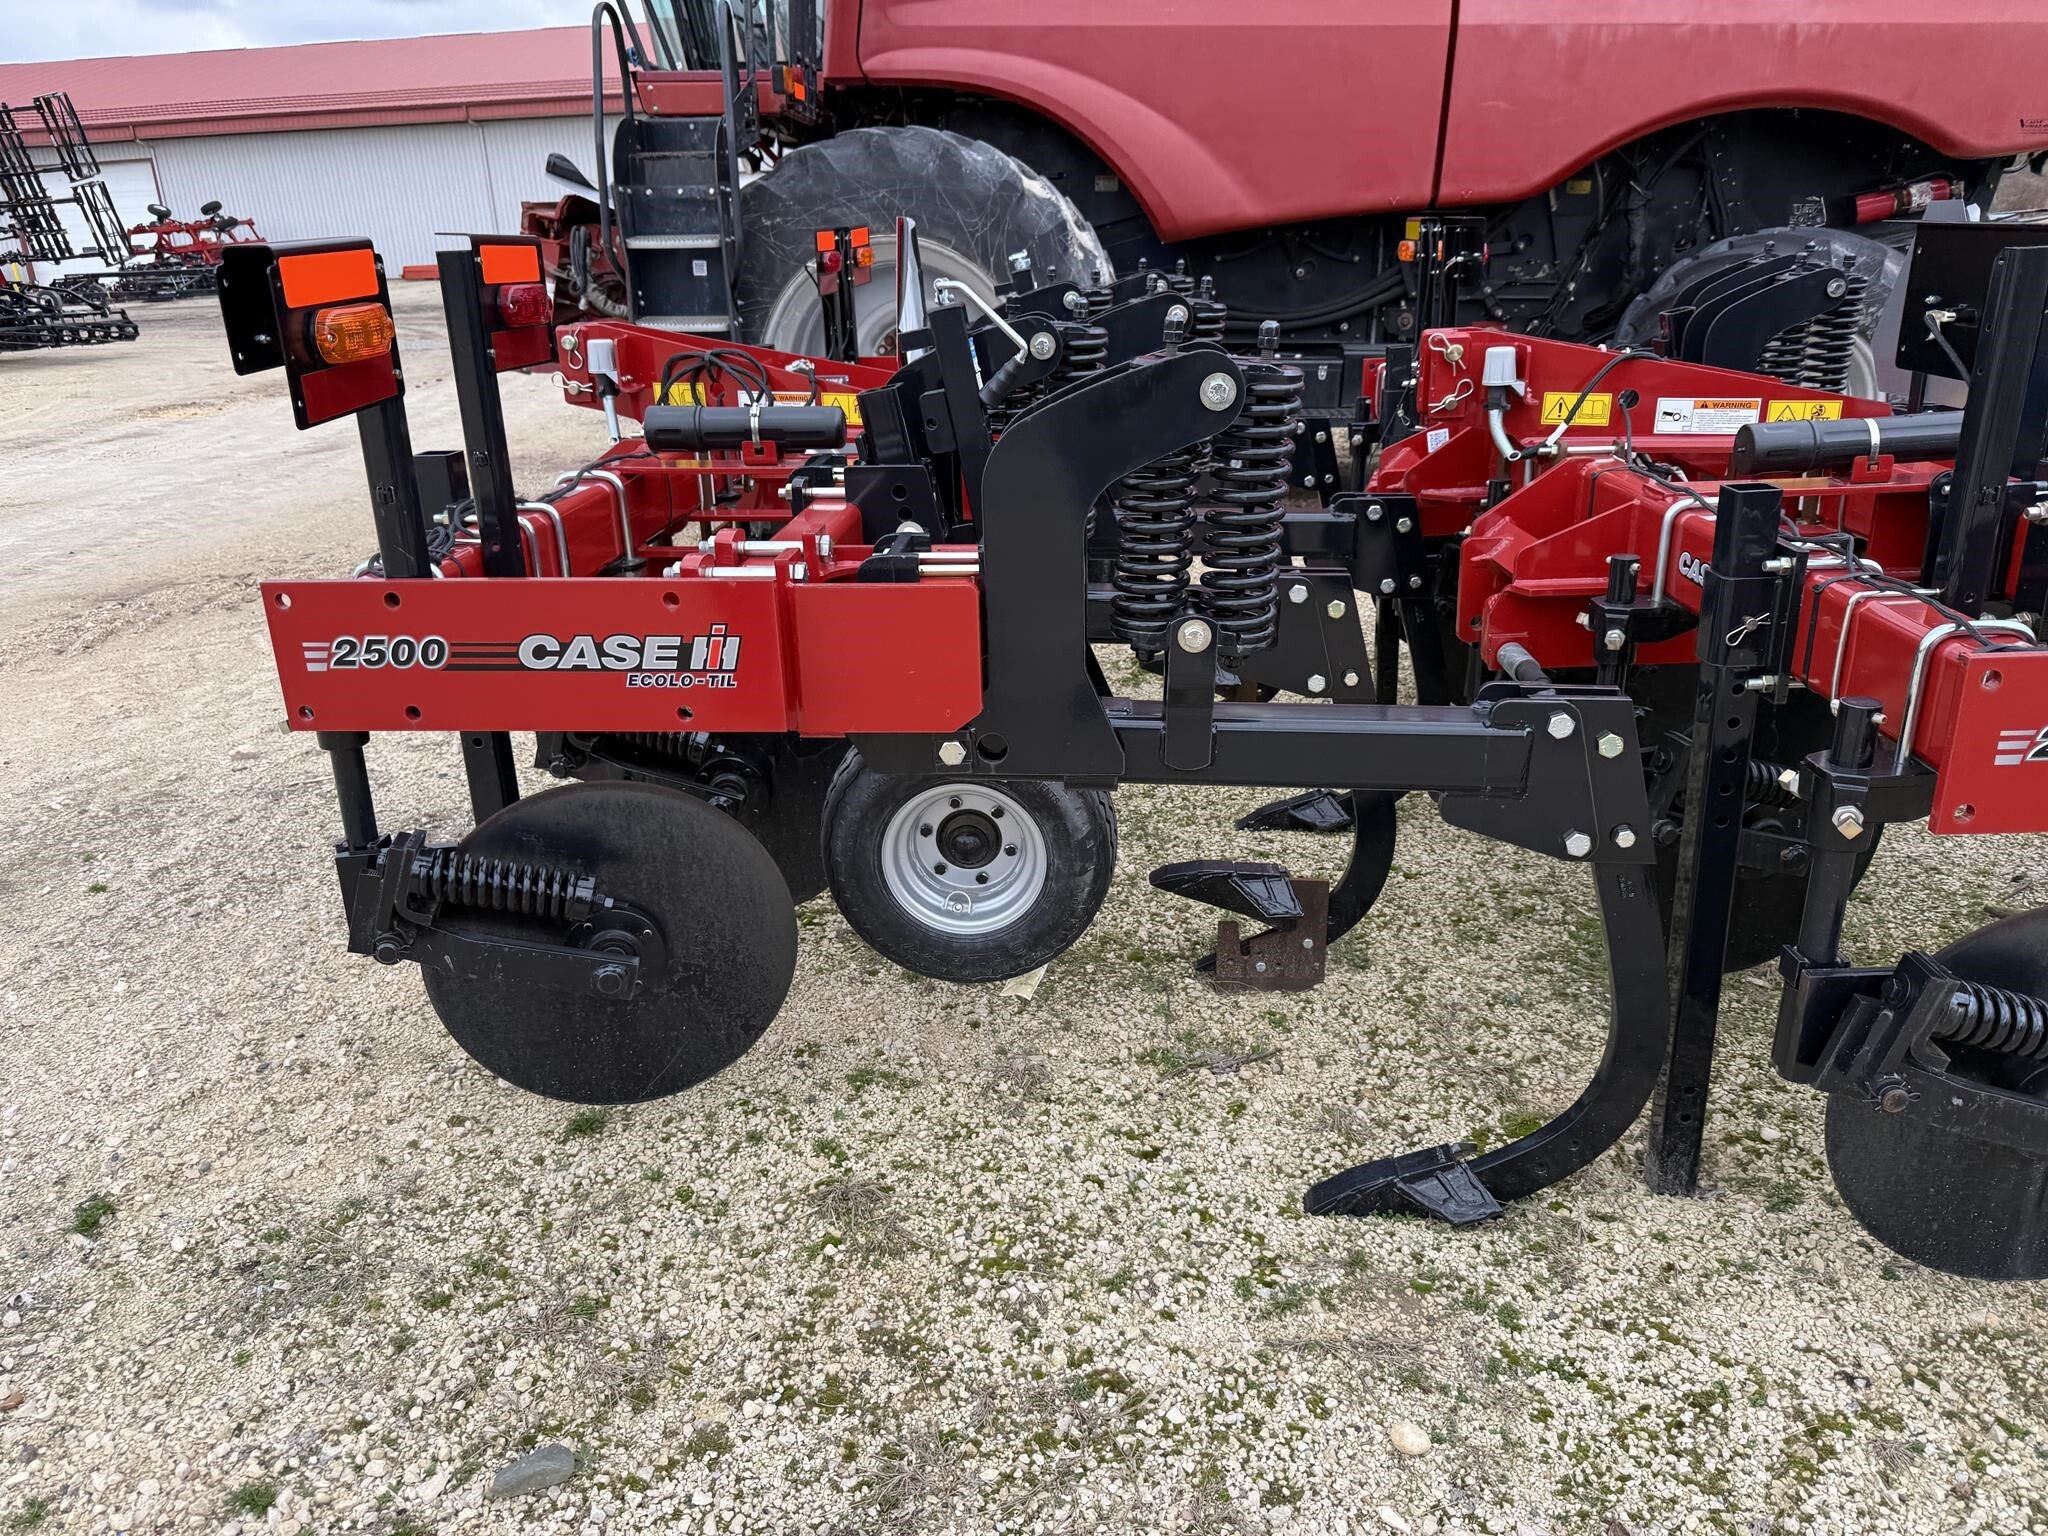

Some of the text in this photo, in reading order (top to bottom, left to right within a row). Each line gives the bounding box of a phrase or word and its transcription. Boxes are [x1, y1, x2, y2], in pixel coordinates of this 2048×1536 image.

[1679, 551, 1710, 586] CAS
[330, 635, 449, 669] 2500
[518, 634, 681, 670] CASE
[626, 673, 738, 688] ECOLO-TIL
